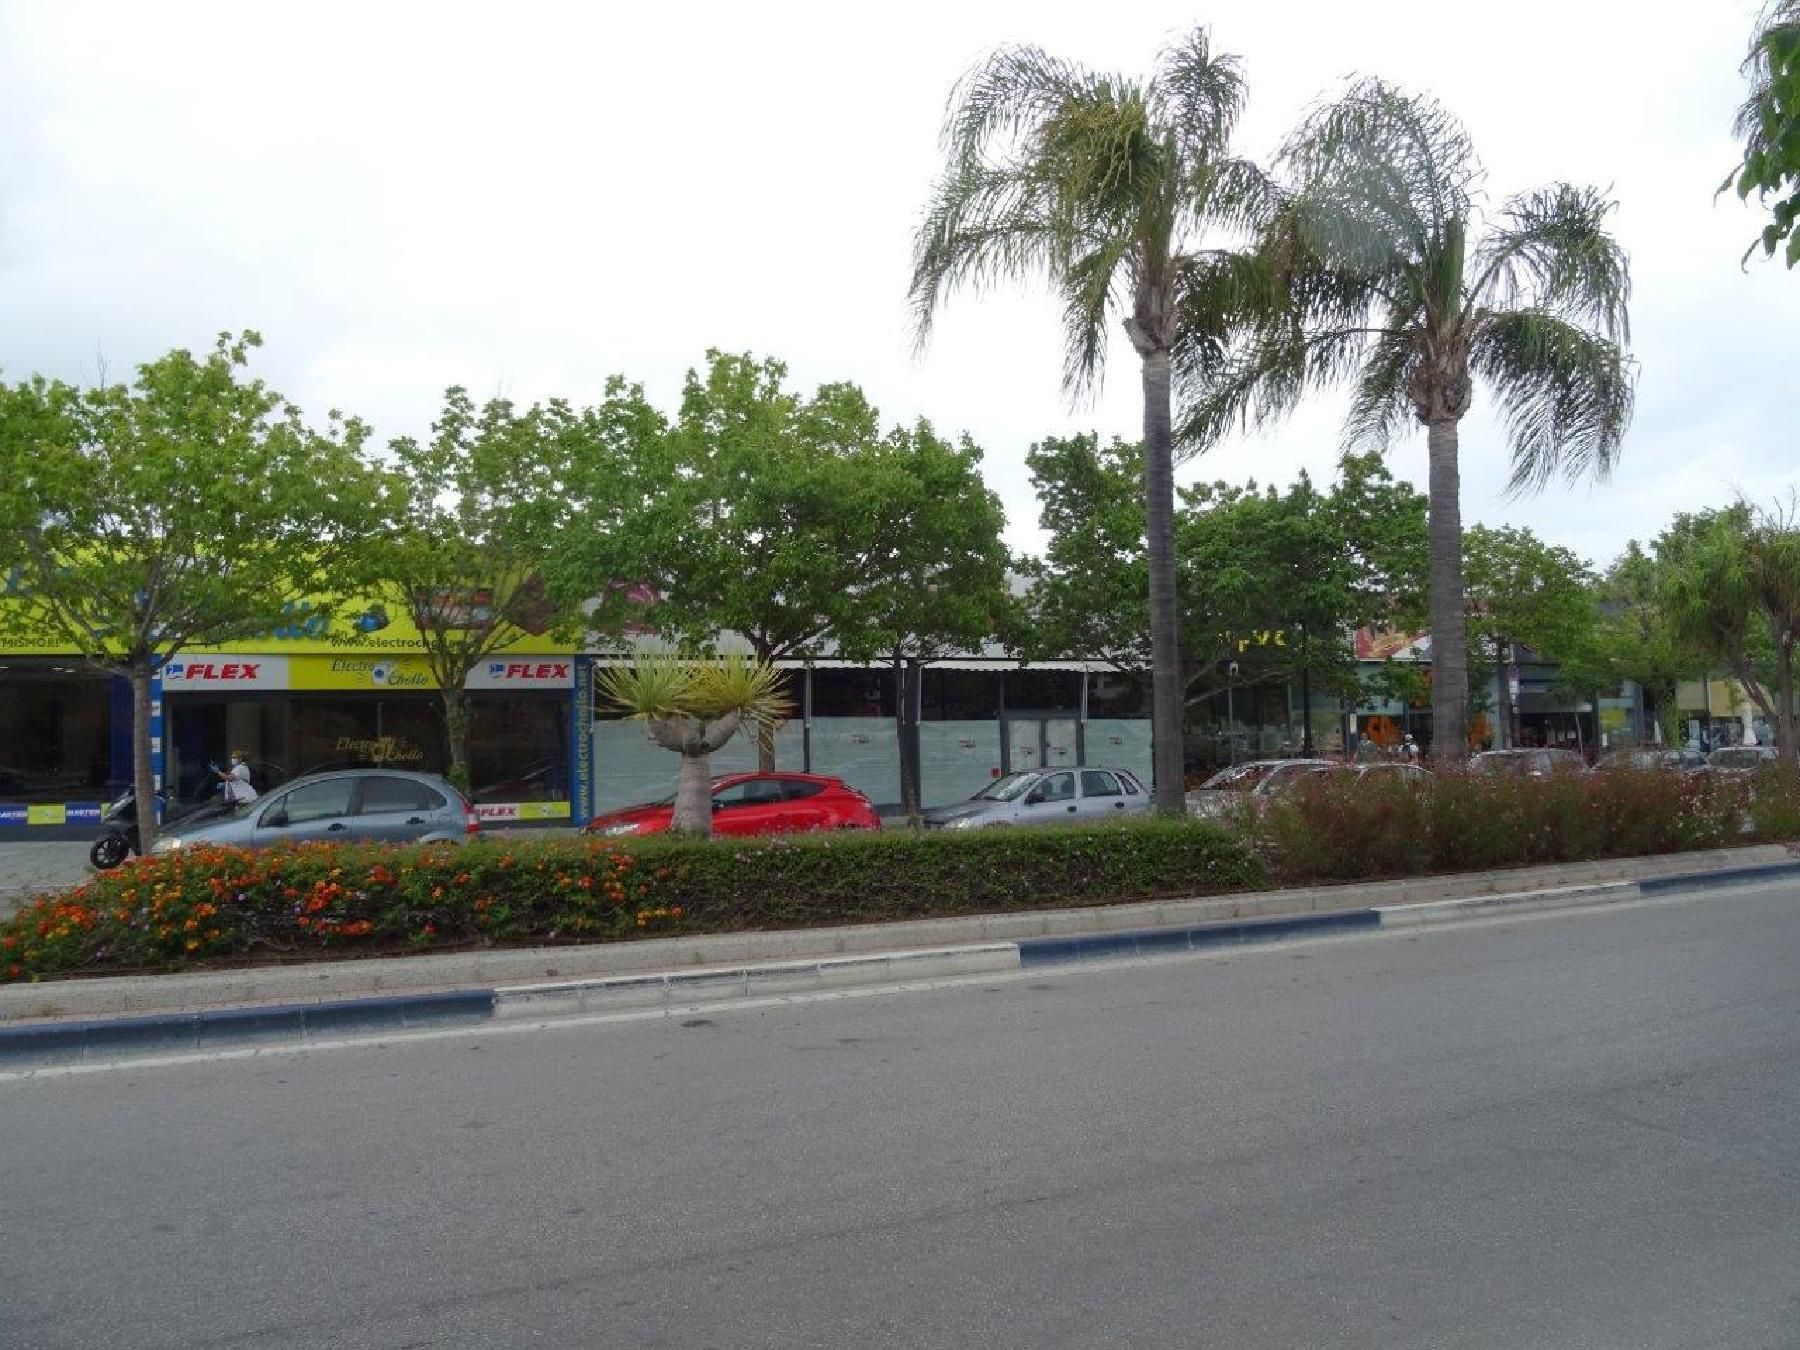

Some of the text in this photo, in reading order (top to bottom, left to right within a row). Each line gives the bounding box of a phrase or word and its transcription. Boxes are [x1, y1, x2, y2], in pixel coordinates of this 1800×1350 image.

[185, 664, 260, 680] FLEX
[505, 664, 570, 679] FLEX
[480, 807, 516, 817] FLEX
